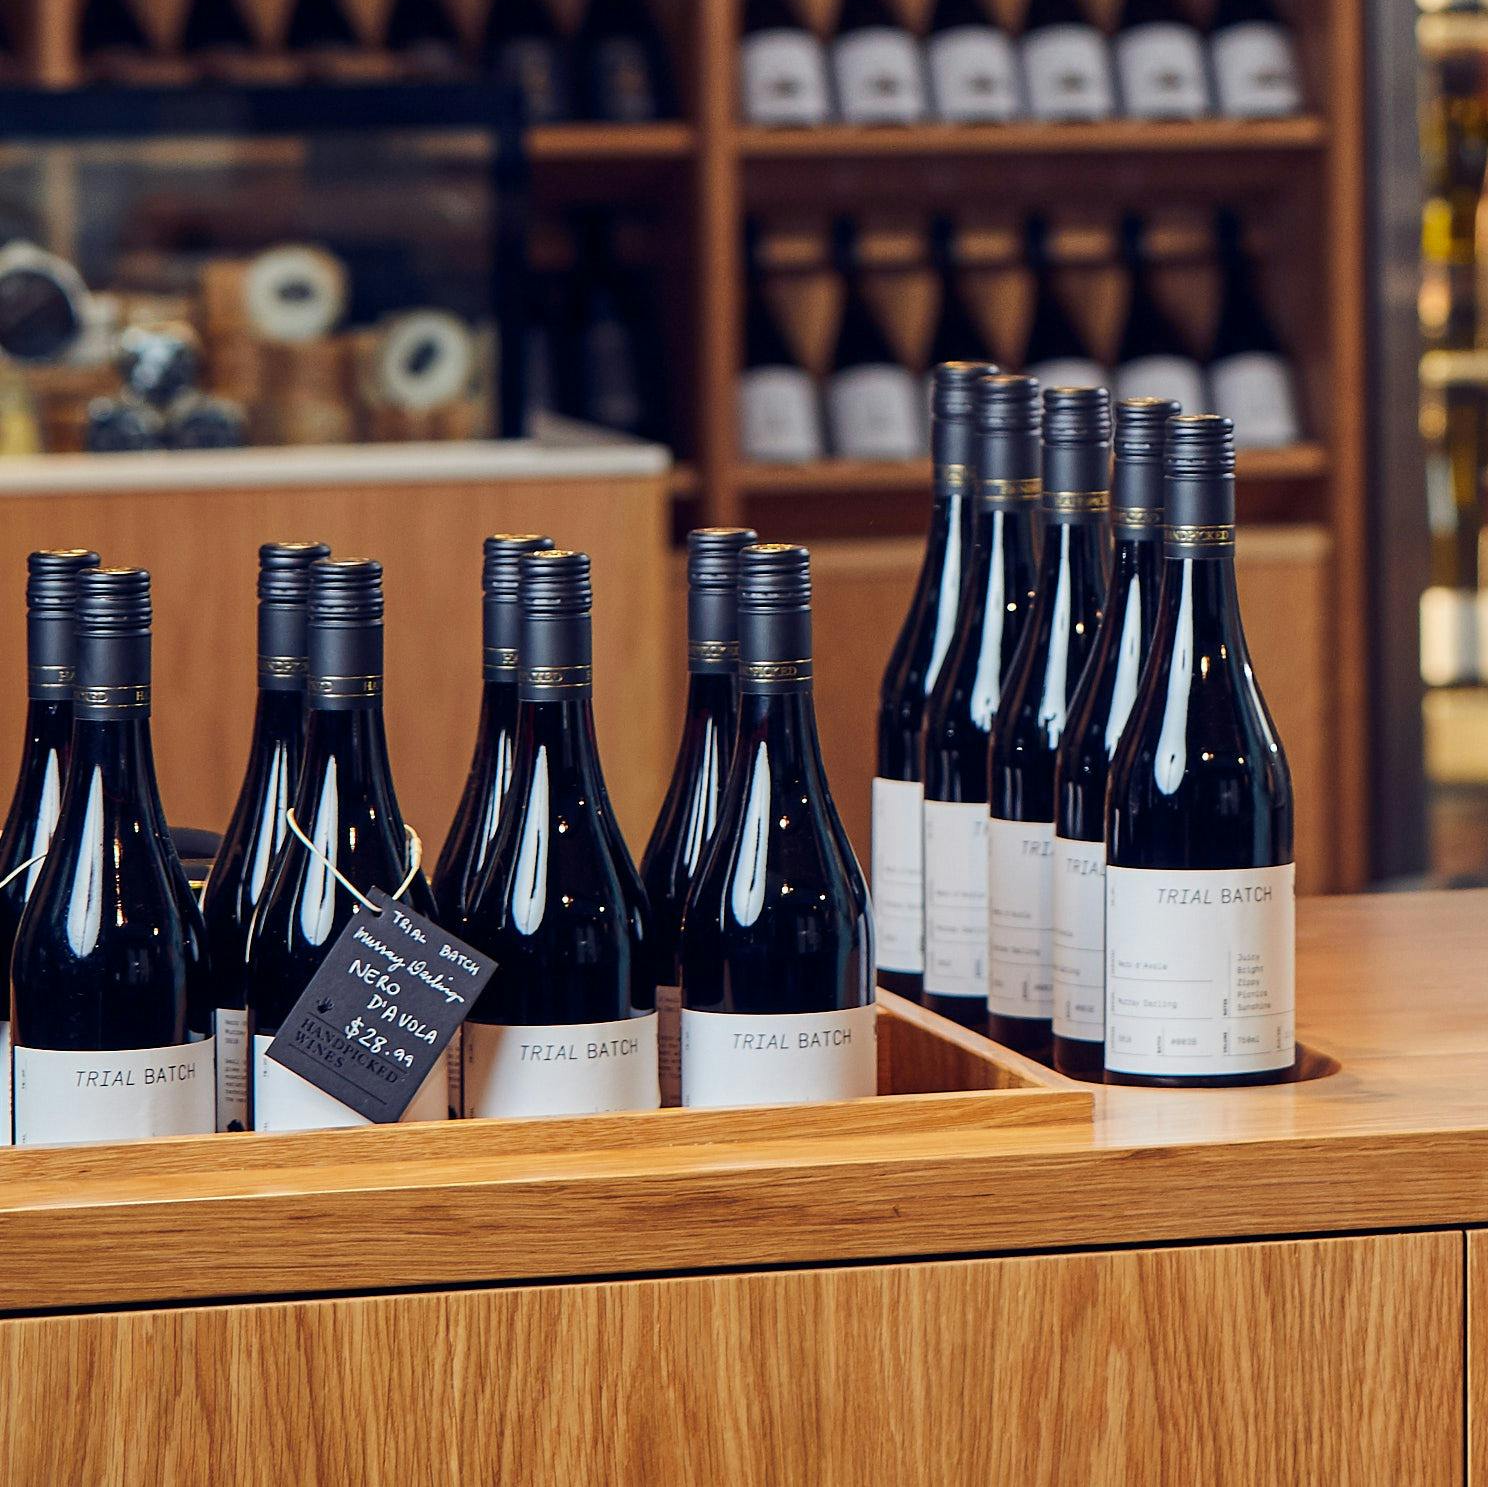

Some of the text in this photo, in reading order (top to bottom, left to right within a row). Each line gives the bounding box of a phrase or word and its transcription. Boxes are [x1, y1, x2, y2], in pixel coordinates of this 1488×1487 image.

[1021, 840, 1054, 857] TRI
[1158, 886, 1273, 905] TRIAL BATCH
[393, 909, 481, 976] TRIAL BATCH
[348, 959, 401, 996] NERO
[293, 1030, 346, 1069] WINES
[299, 1018, 401, 1085] HANDPICKED
[345, 1016, 414, 1068] $28.99
[520, 1037, 639, 1061] TRIAL BATCH
[733, 1028, 852, 1050] TRIAL BATCH
[75, 1062, 196, 1087] TRIAL BATCH
